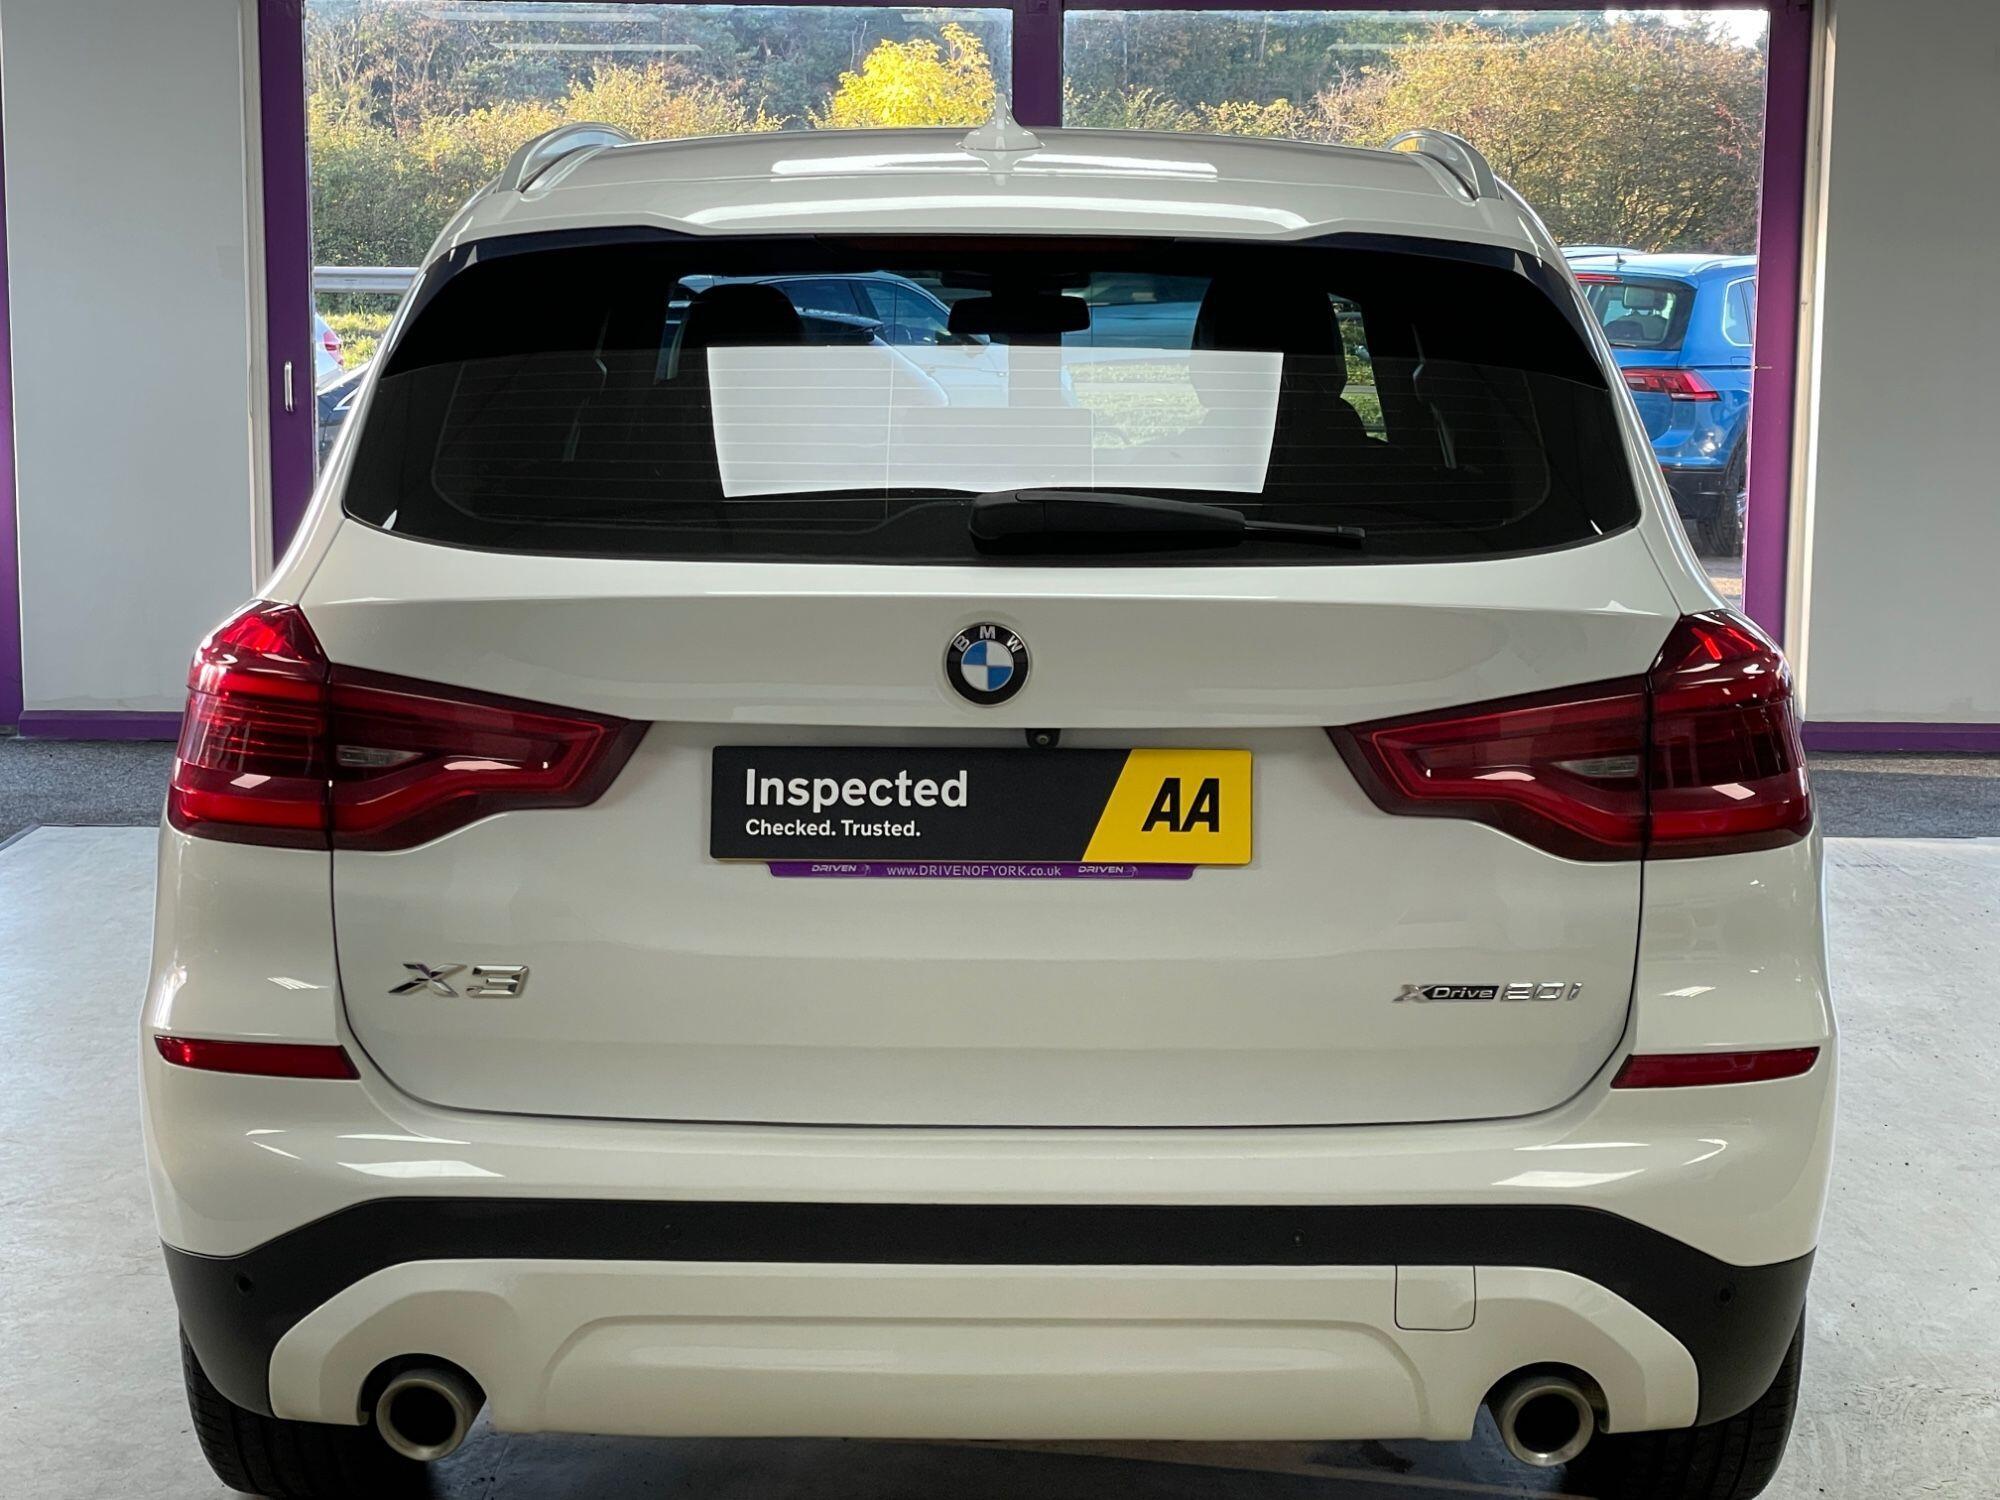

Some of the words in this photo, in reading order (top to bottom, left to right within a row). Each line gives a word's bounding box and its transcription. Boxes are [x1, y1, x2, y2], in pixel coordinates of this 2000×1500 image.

[952, 625, 1024, 653] BMW
[745, 768, 968, 813] Inspected
[1141, 777, 1220, 833] AA
[745, 818, 837, 836] Checked.
[840, 819, 921, 837] Trusted.
[811, 864, 857, 873] DRIVEN
[886, 865, 1062, 877] www.DRIVENOFYORK.co.uk
[1078, 865, 1124, 874] DRIVEN
[388, 963, 530, 998] X3
